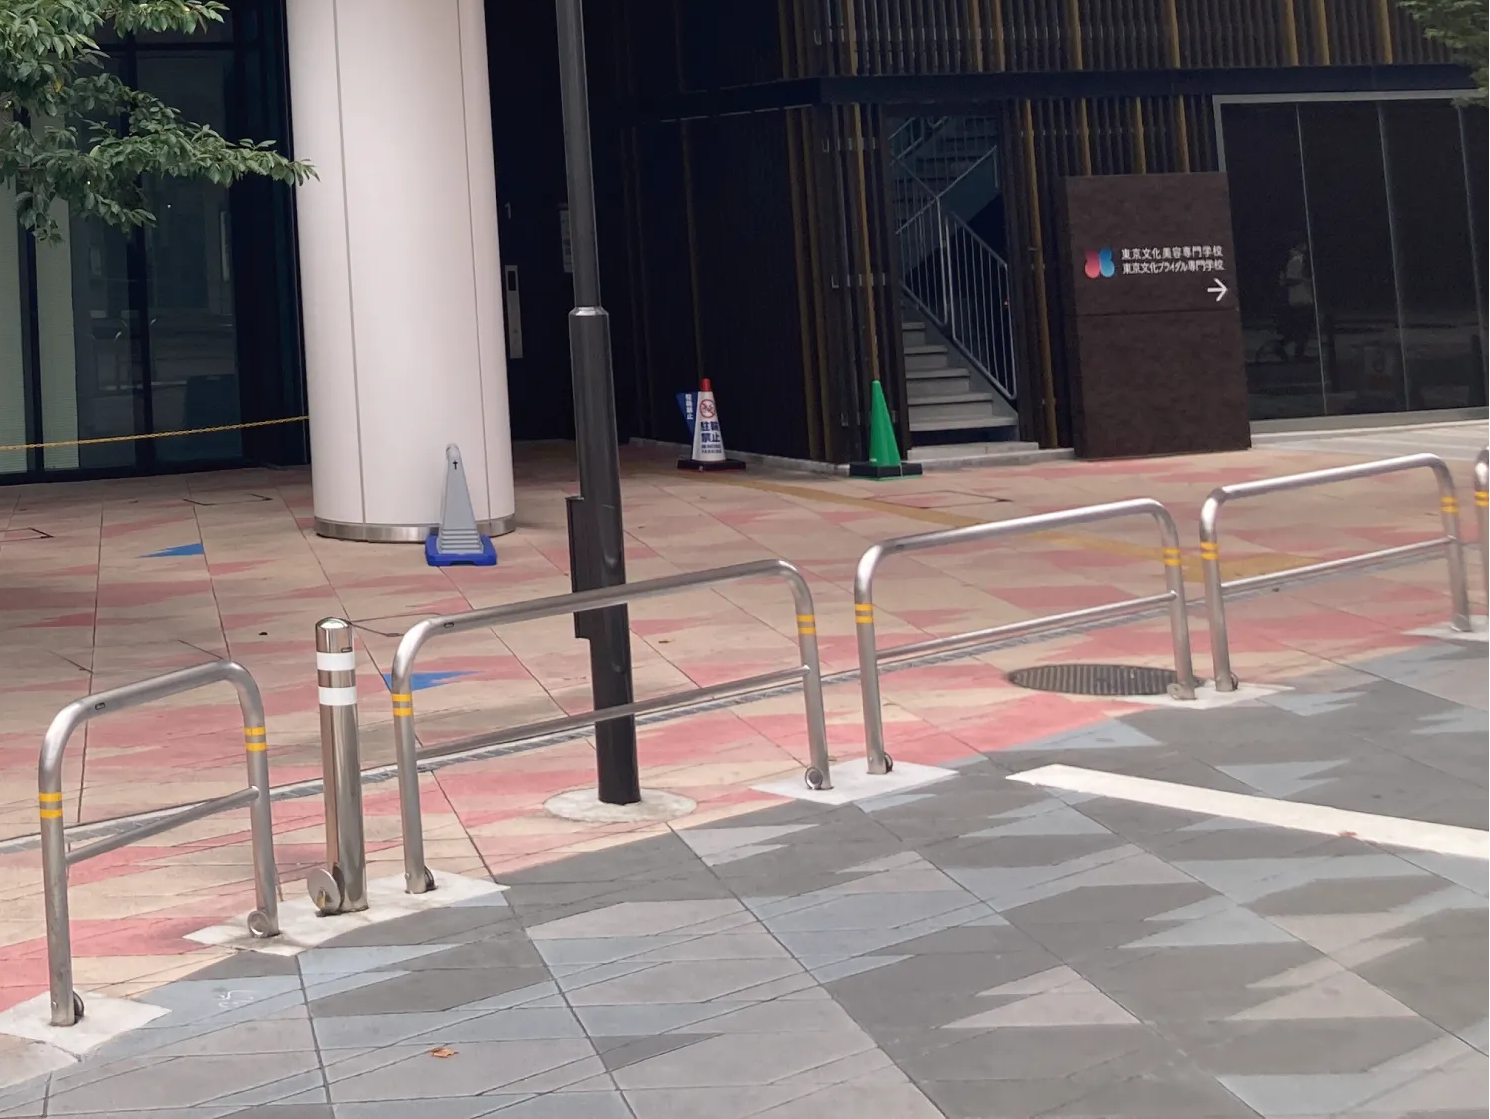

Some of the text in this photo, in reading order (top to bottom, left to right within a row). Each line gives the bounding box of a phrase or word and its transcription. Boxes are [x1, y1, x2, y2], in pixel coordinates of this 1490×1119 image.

[1121, 245, 1224, 260] 東京文化美容専門学校
[1122, 259, 1226, 274] 東京文化ブライダル専門学校
